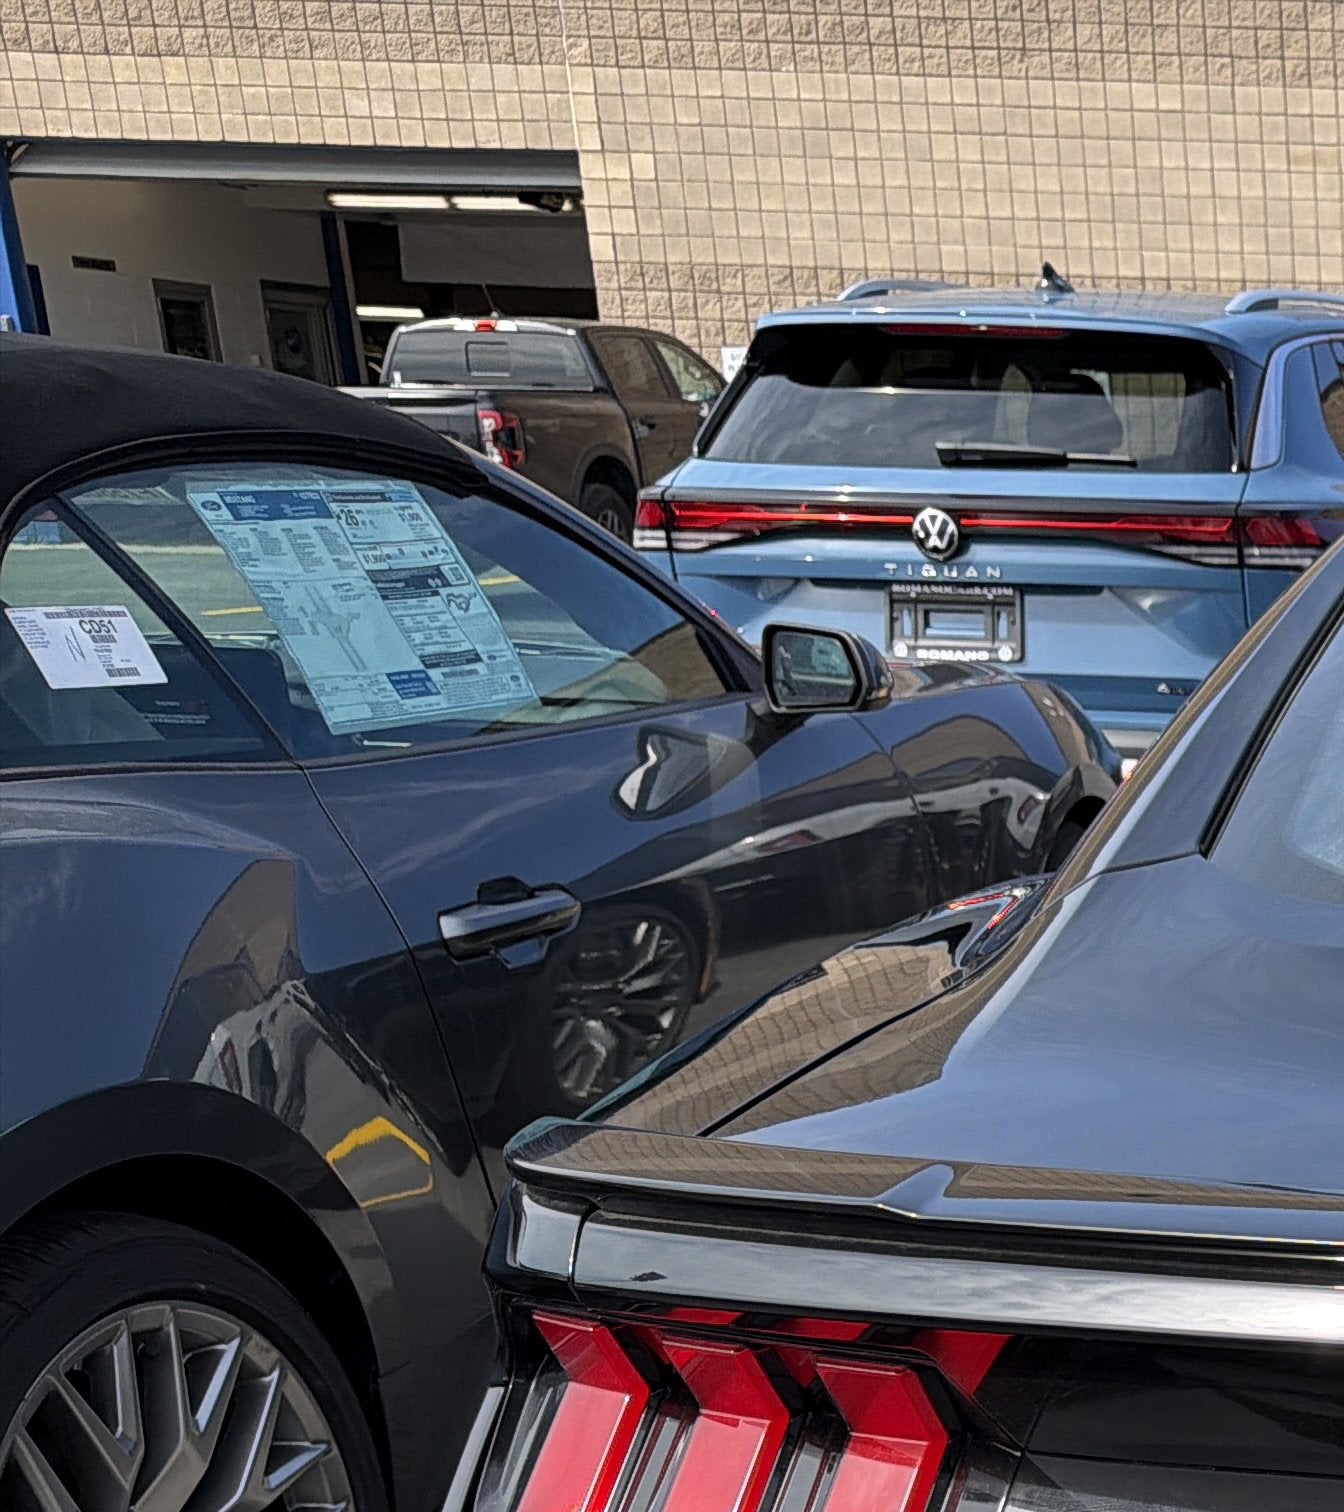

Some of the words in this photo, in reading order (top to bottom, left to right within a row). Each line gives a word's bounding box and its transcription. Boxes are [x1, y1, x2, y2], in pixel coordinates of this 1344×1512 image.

[341, 509, 359, 526] 26
[884, 563, 1001, 578] TIGUAN
[78, 619, 118, 634] CD51
